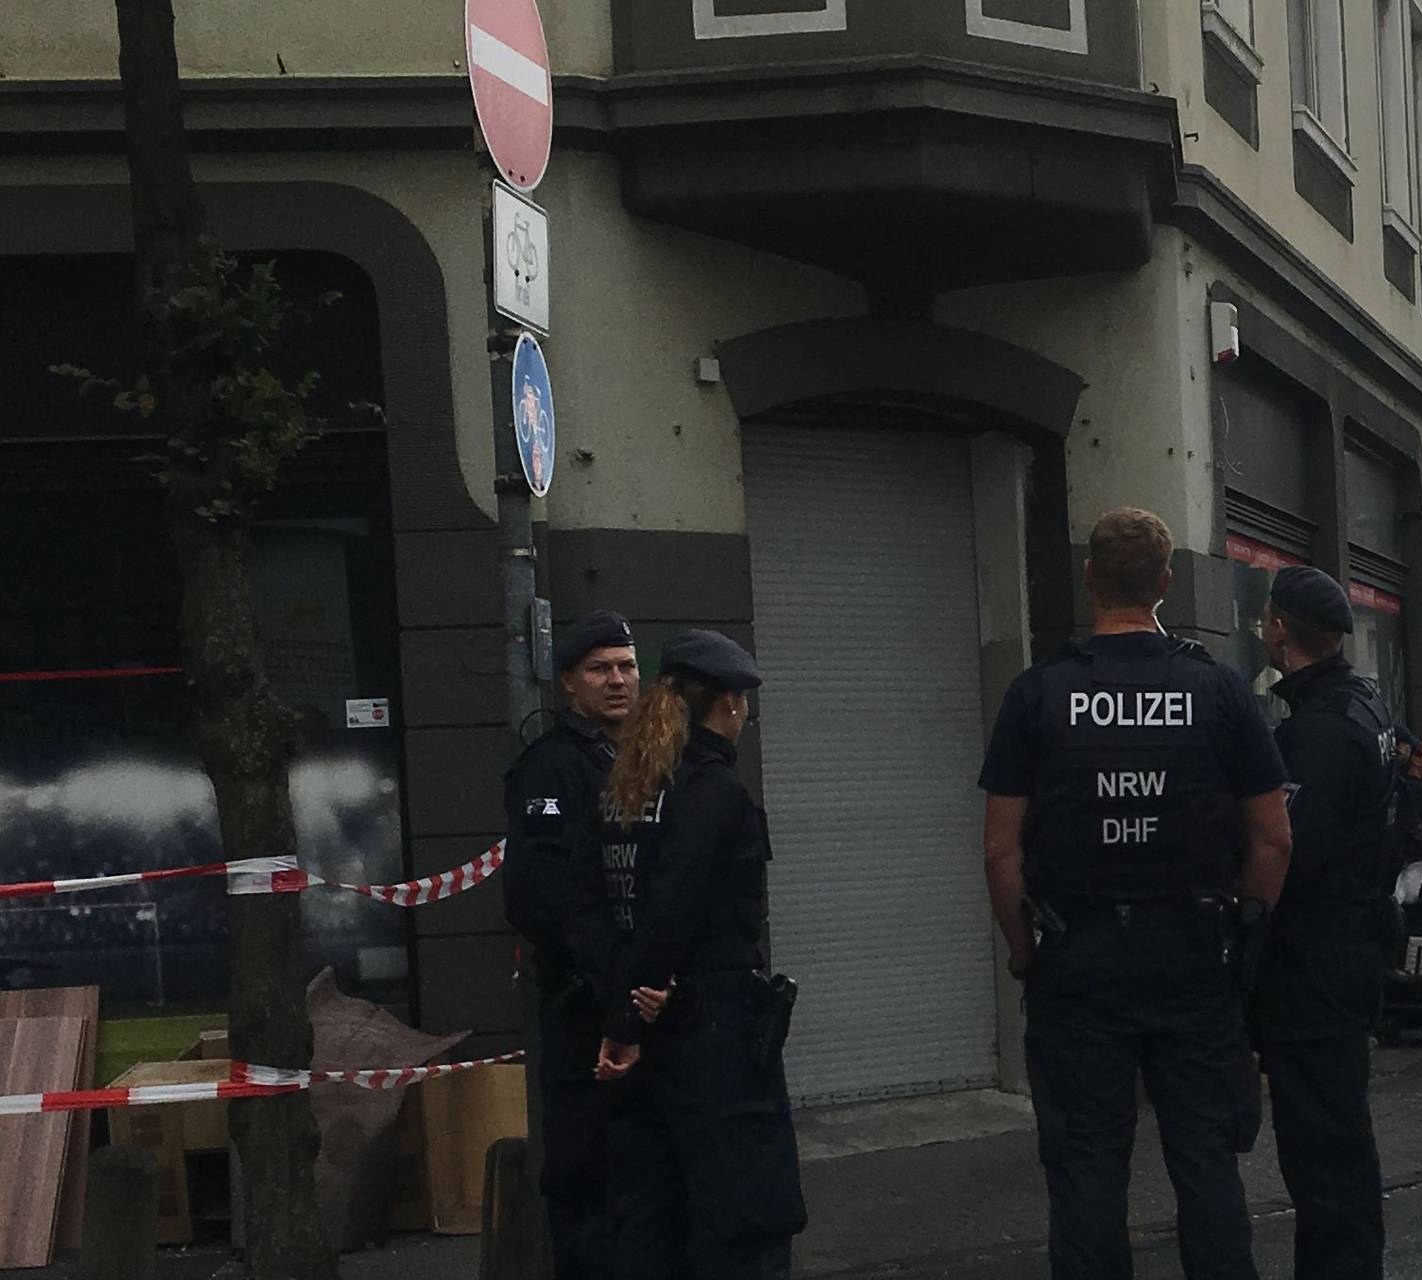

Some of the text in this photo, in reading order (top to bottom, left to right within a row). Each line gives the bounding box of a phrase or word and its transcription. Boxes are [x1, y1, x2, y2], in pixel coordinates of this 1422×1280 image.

[1069, 691, 1193, 726] POLIZEI
[1097, 771, 1166, 797] NRW
[1103, 817, 1158, 843] DHF
